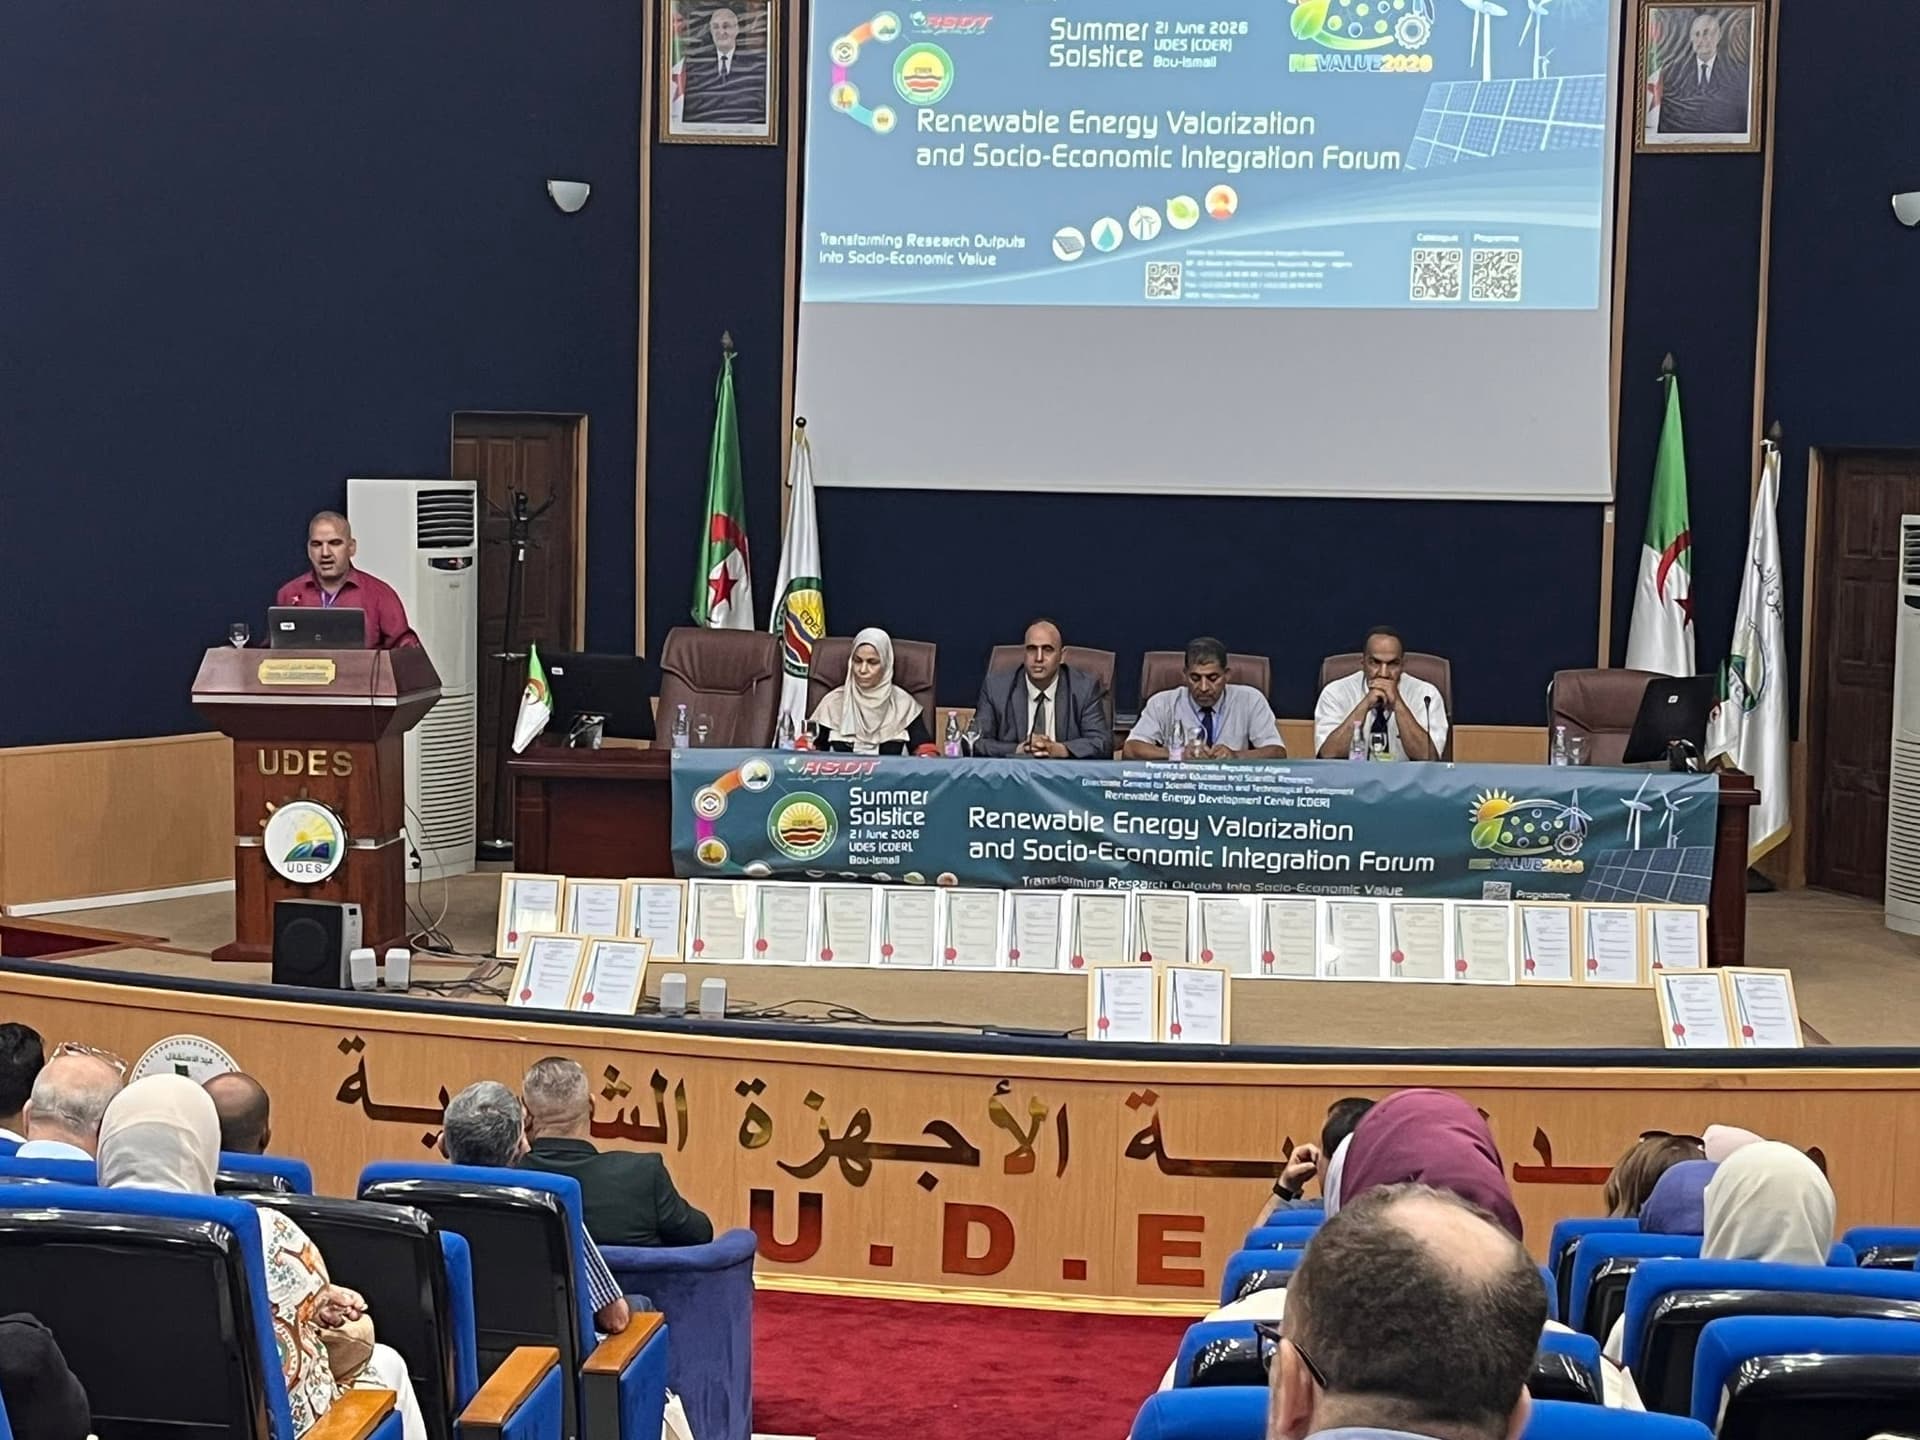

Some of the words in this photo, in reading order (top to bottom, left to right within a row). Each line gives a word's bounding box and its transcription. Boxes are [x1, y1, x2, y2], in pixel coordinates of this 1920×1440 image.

[1050, 17, 1149, 41] Summer
[1155, 21, 1169, 35] 21
[1175, 21, 1205, 35] June
[1209, 21, 1249, 35] 2026
[1154, 38, 1188, 51] UDES
[1049, 44, 1144, 68] Solstice
[917, 108, 1059, 134] Renewable
[1069, 110, 1158, 139] Energy
[1166, 110, 1315, 135] Valorization
[916, 143, 965, 167] and
[972, 143, 1172, 169] Socio-Economic
[1181, 144, 1314, 174] Integration
[1322, 145, 1401, 171] Forum
[820, 232, 903, 249] Transforming
[907, 233, 970, 248] Research
[974, 234, 1026, 250] Outputs
[848, 250, 954, 265] Socio-Economic
[958, 252, 997, 266] Value
[258, 749, 353, 777] UDES
[849, 787, 929, 806] Summer
[1104, 790, 1159, 802] Renewable
[1162, 792, 1196, 805] Energy
[1198, 793, 1262, 806] Development
[1263, 796, 1295, 807] Center
[849, 807, 926, 826] Solstice
[969, 806, 1105, 833] Renewable
[1113, 811, 1199, 841] Energy
[1207, 815, 1353, 841] Valorization
[849, 829, 863, 840] 21
[866, 829, 888, 840] June
[891, 829, 920, 840] 2026
[849, 842, 876, 852] UDES
[969, 838, 1014, 860] and
[1023, 839, 1214, 868] Socio-Economic
[1221, 846, 1350, 874] Integration
[1359, 851, 1435, 872] Forum
[287, 862, 323, 874] UDES
[1022, 875, 1105, 890] Transforming
[1108, 877, 1168, 890] Research
[1256, 882, 1360, 895] Socio-Economic
[1364, 885, 1403, 896] Value
[733, 1073, 1068, 1192] الأجهزة
